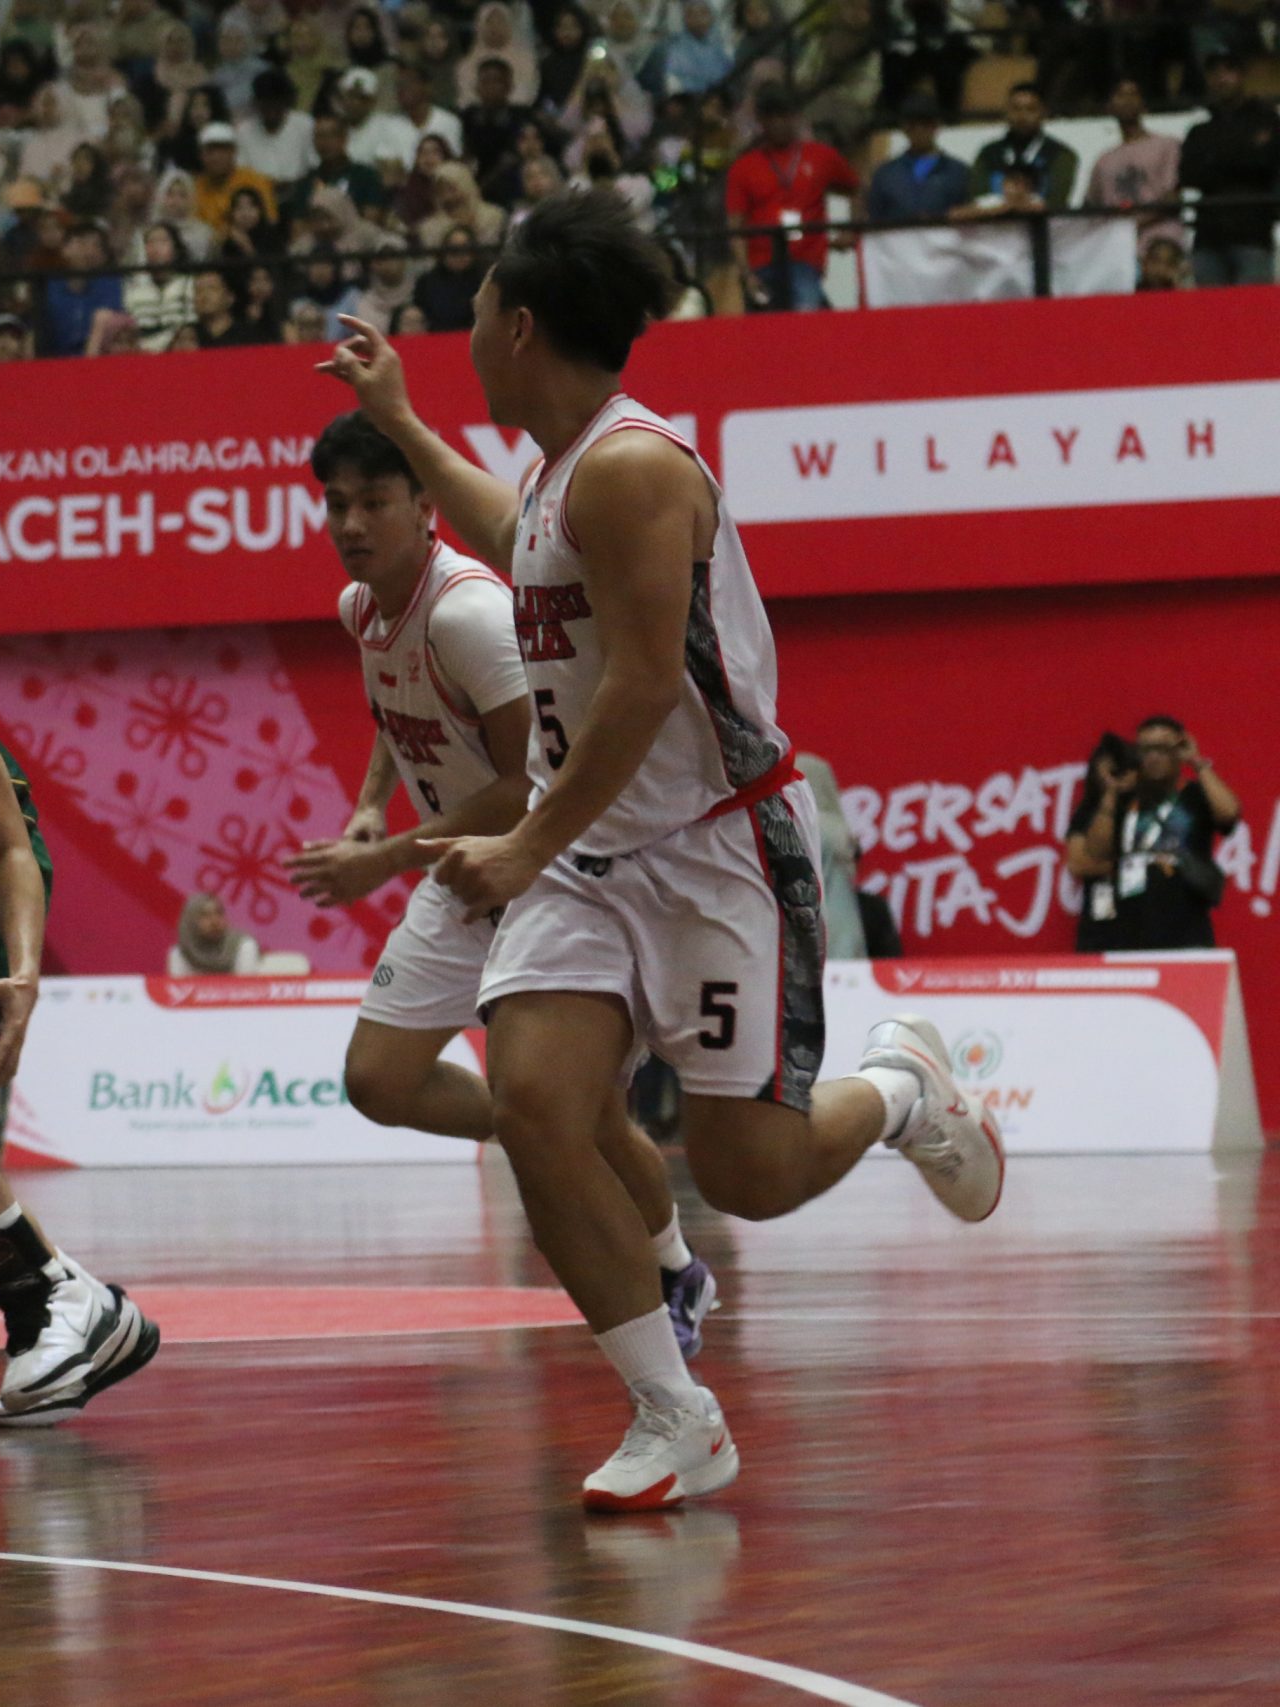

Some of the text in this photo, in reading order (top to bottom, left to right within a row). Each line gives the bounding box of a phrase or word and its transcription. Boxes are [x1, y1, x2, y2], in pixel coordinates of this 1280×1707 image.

[72, 436, 266, 479] OLAHRAGA
[791, 418, 1216, 480] WILAYAH
[534, 688, 570, 770] 5
[699, 981, 739, 1049] 5
[86, 1070, 197, 1111] Bank
